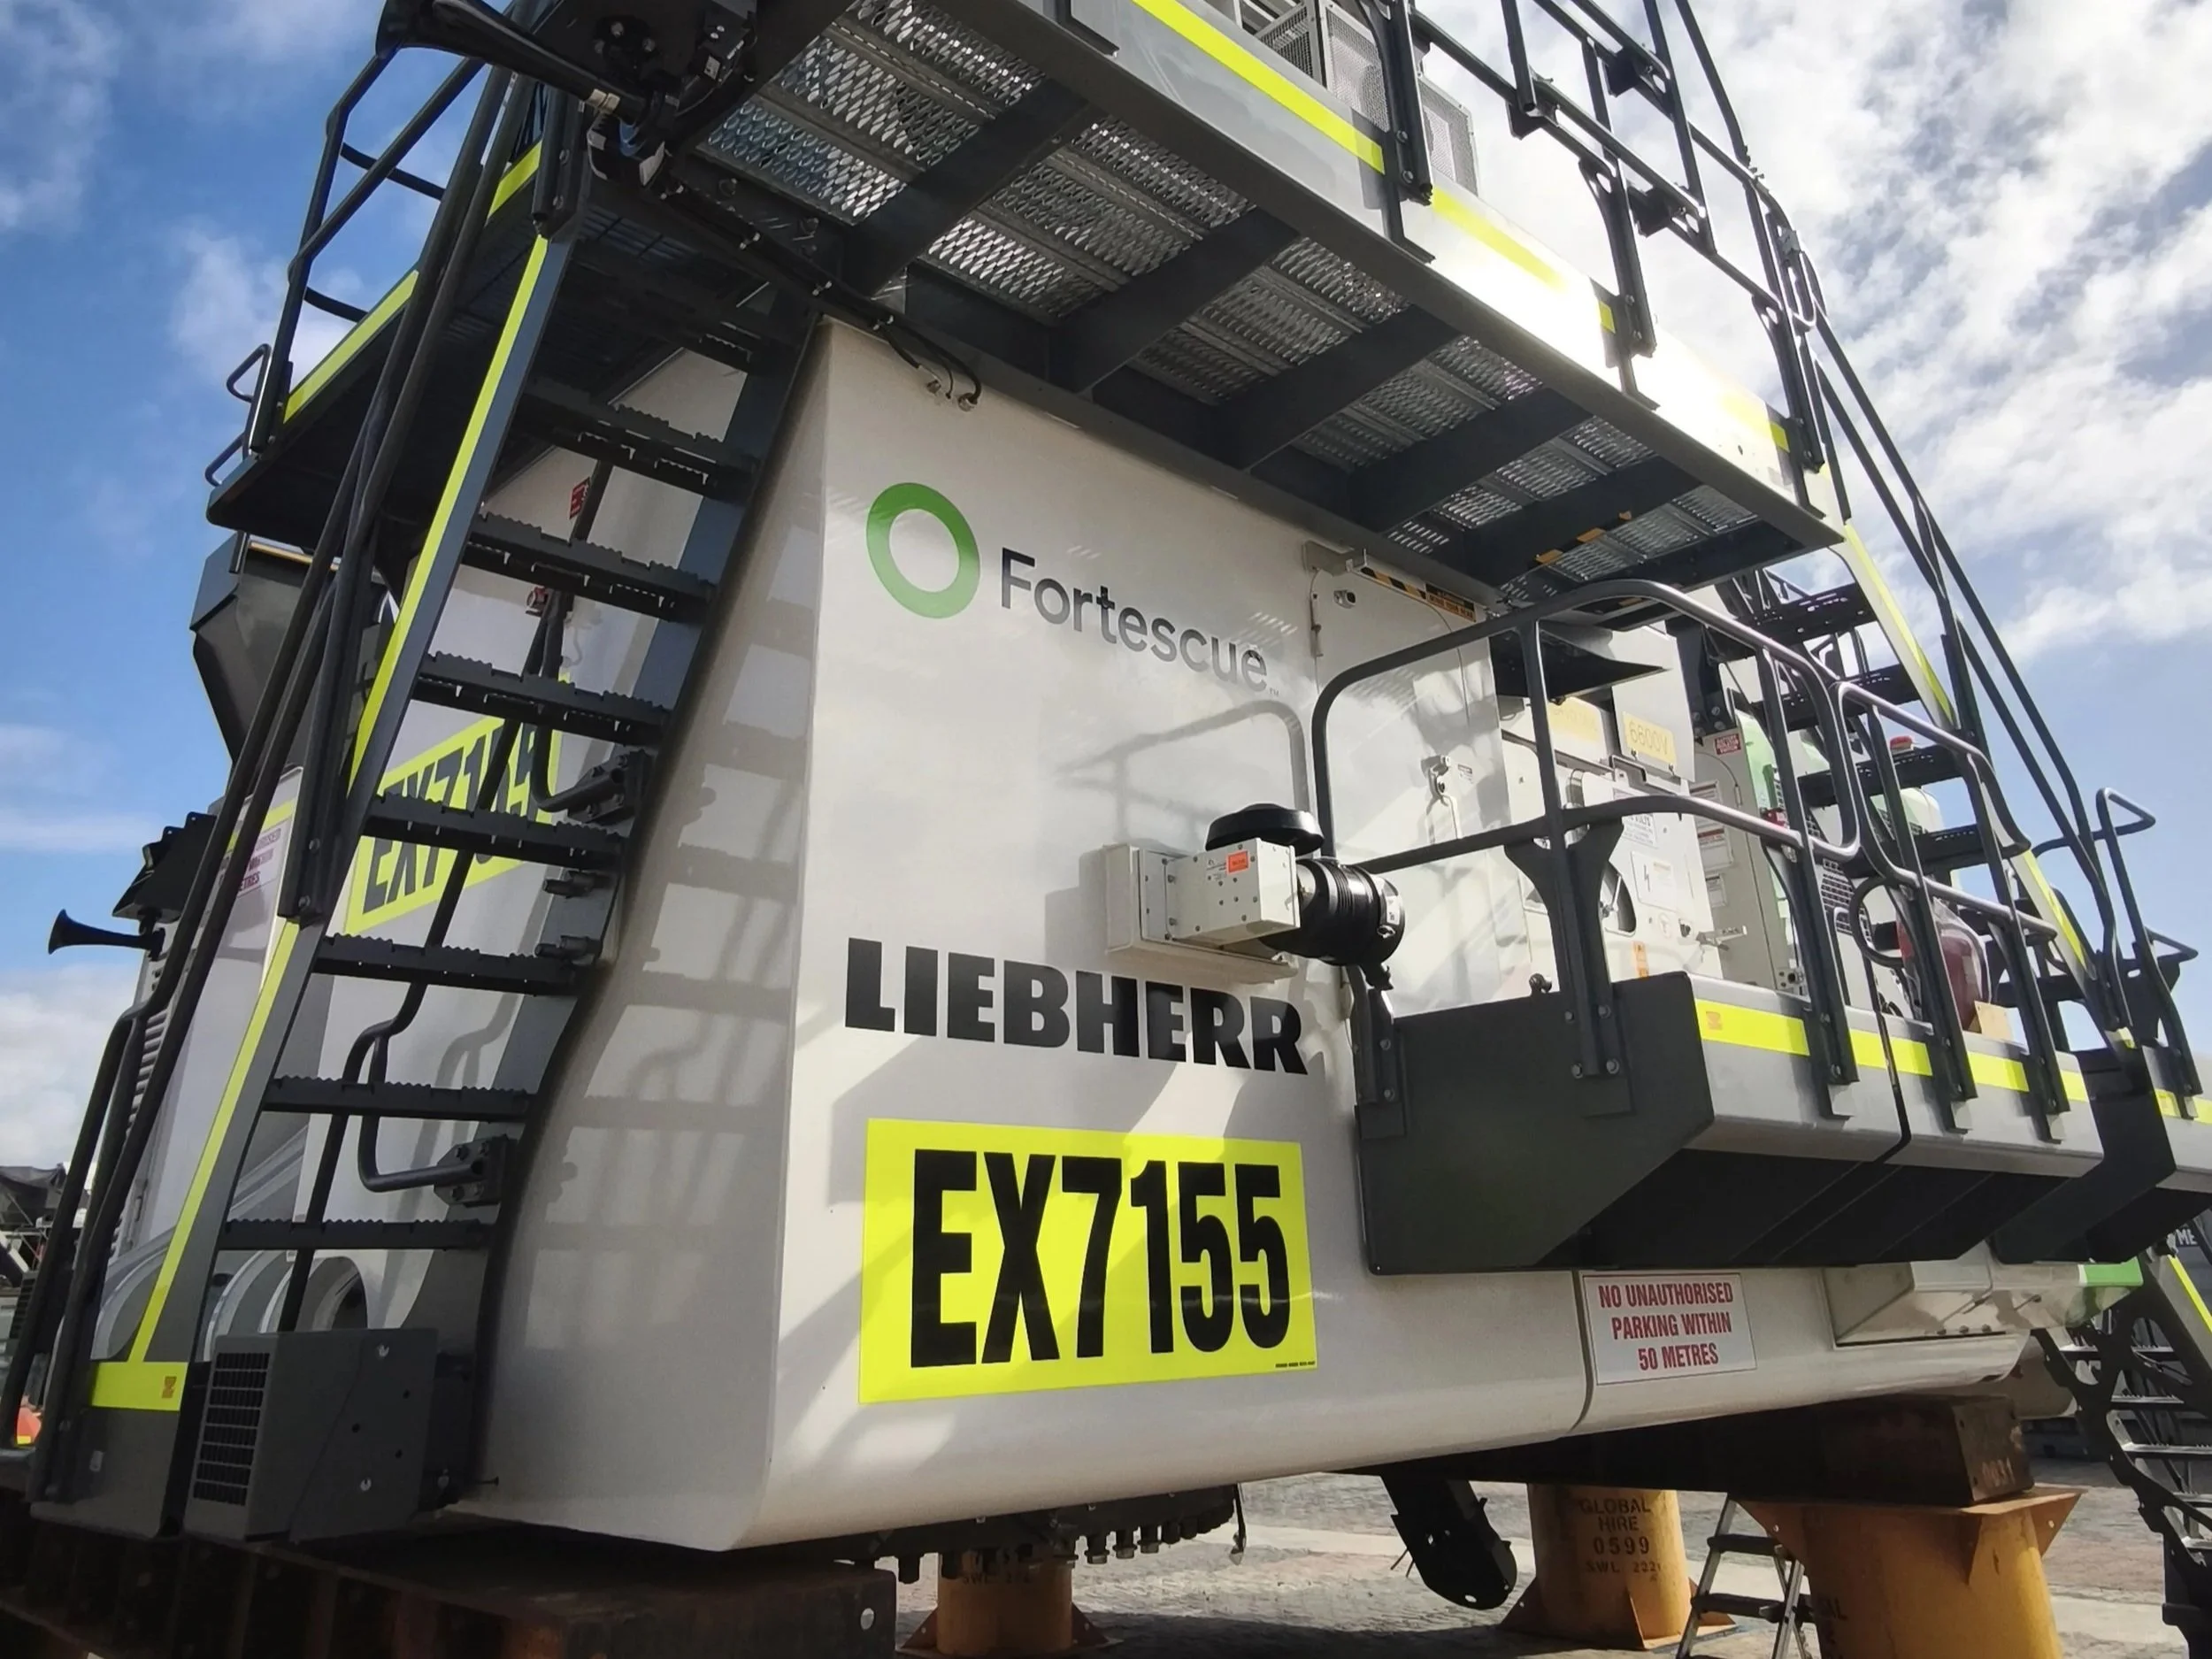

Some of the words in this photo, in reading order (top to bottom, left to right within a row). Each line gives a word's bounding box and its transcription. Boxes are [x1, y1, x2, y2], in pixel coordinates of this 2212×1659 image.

[1001, 547, 1268, 693] Fortescue
[844, 937, 1309, 1075] LIEBHERR
[910, 1148, 1291, 1368] EX7155
[1598, 1285, 1622, 1309] NO
[1625, 1282, 1733, 1307] UNAUTHORISED
[1611, 1314, 1679, 1340] PARKING
[1680, 1311, 1732, 1335] WITHIN
[1638, 1348, 1658, 1371] 50
[1661, 1342, 1719, 1369] METRES
[1580, 1497, 1651, 1514] GLOBAL
[1598, 1516, 1640, 1532] HIRE
[1593, 1536, 1650, 1555] 0599
